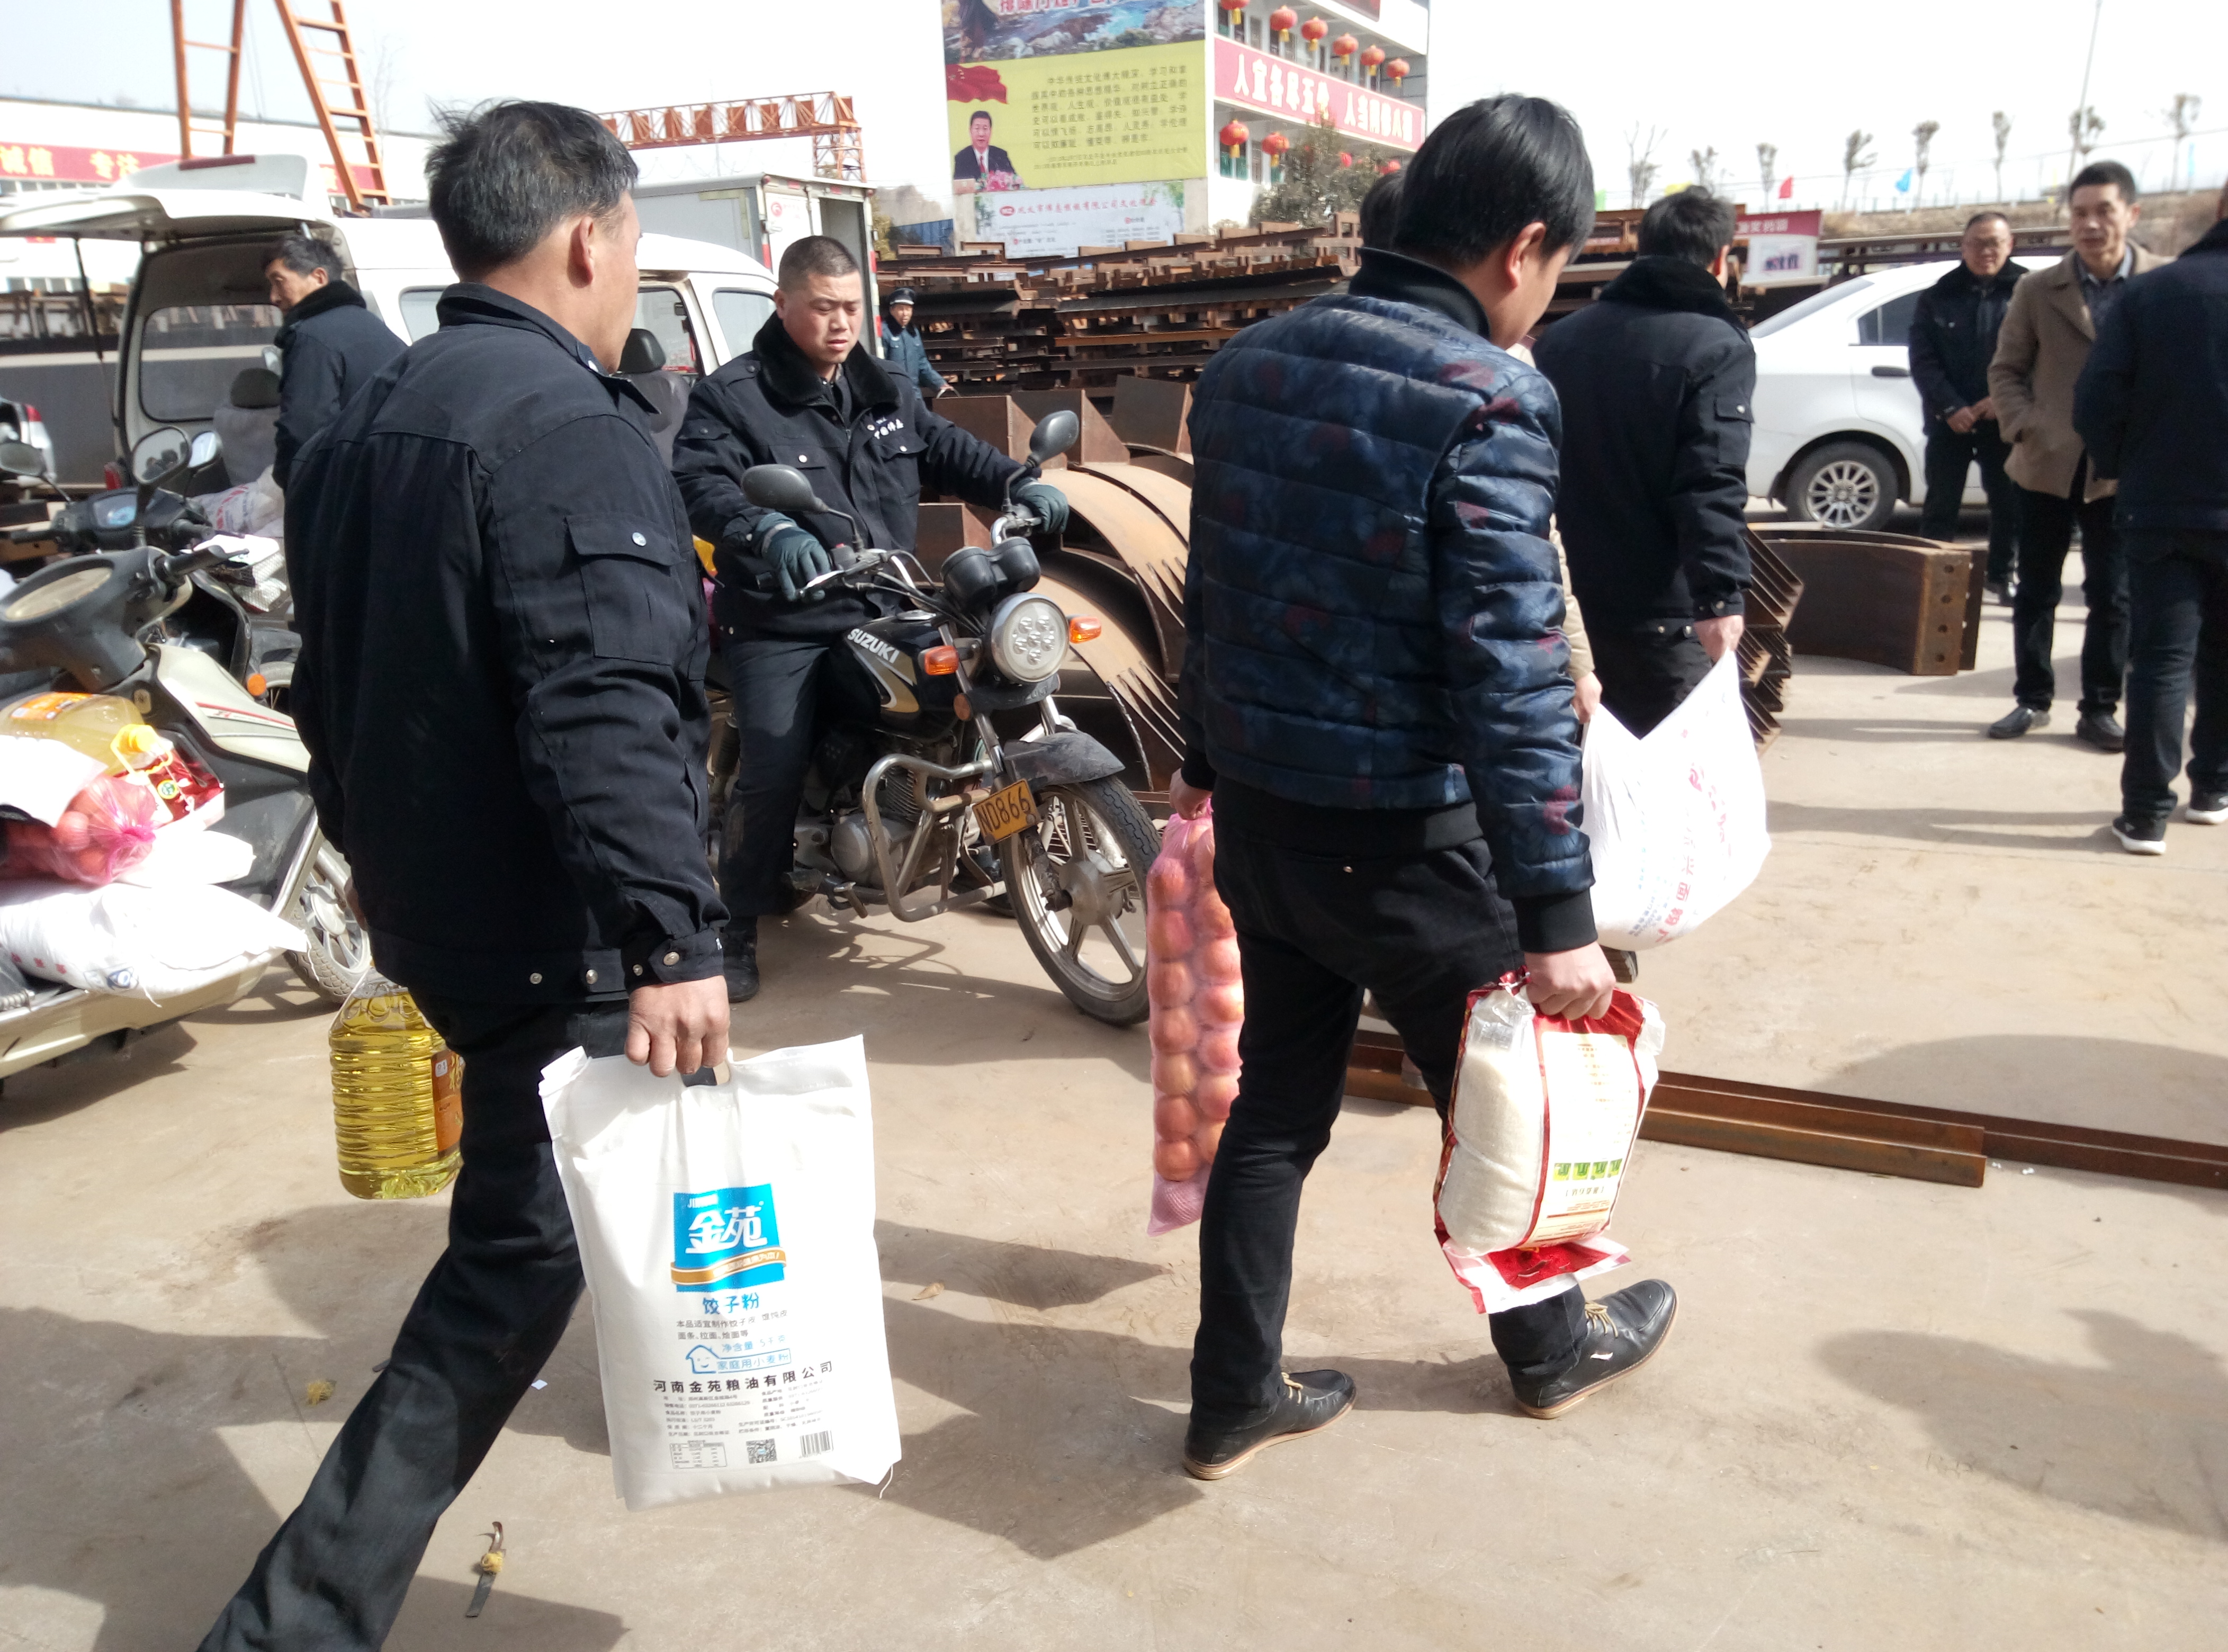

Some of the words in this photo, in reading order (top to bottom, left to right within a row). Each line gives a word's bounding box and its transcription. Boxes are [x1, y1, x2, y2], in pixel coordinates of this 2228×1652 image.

[847, 629, 900, 663] SUZUKI
[685, 1206, 768, 1253] 金苑
[703, 1292, 759, 1315] 饺子粉
[722, 1341, 753, 1353] 净含量
[717, 1353, 789, 1370] 家庭用小麦粉
[653, 1361, 832, 1393] 河南金苑粮油有限公司
